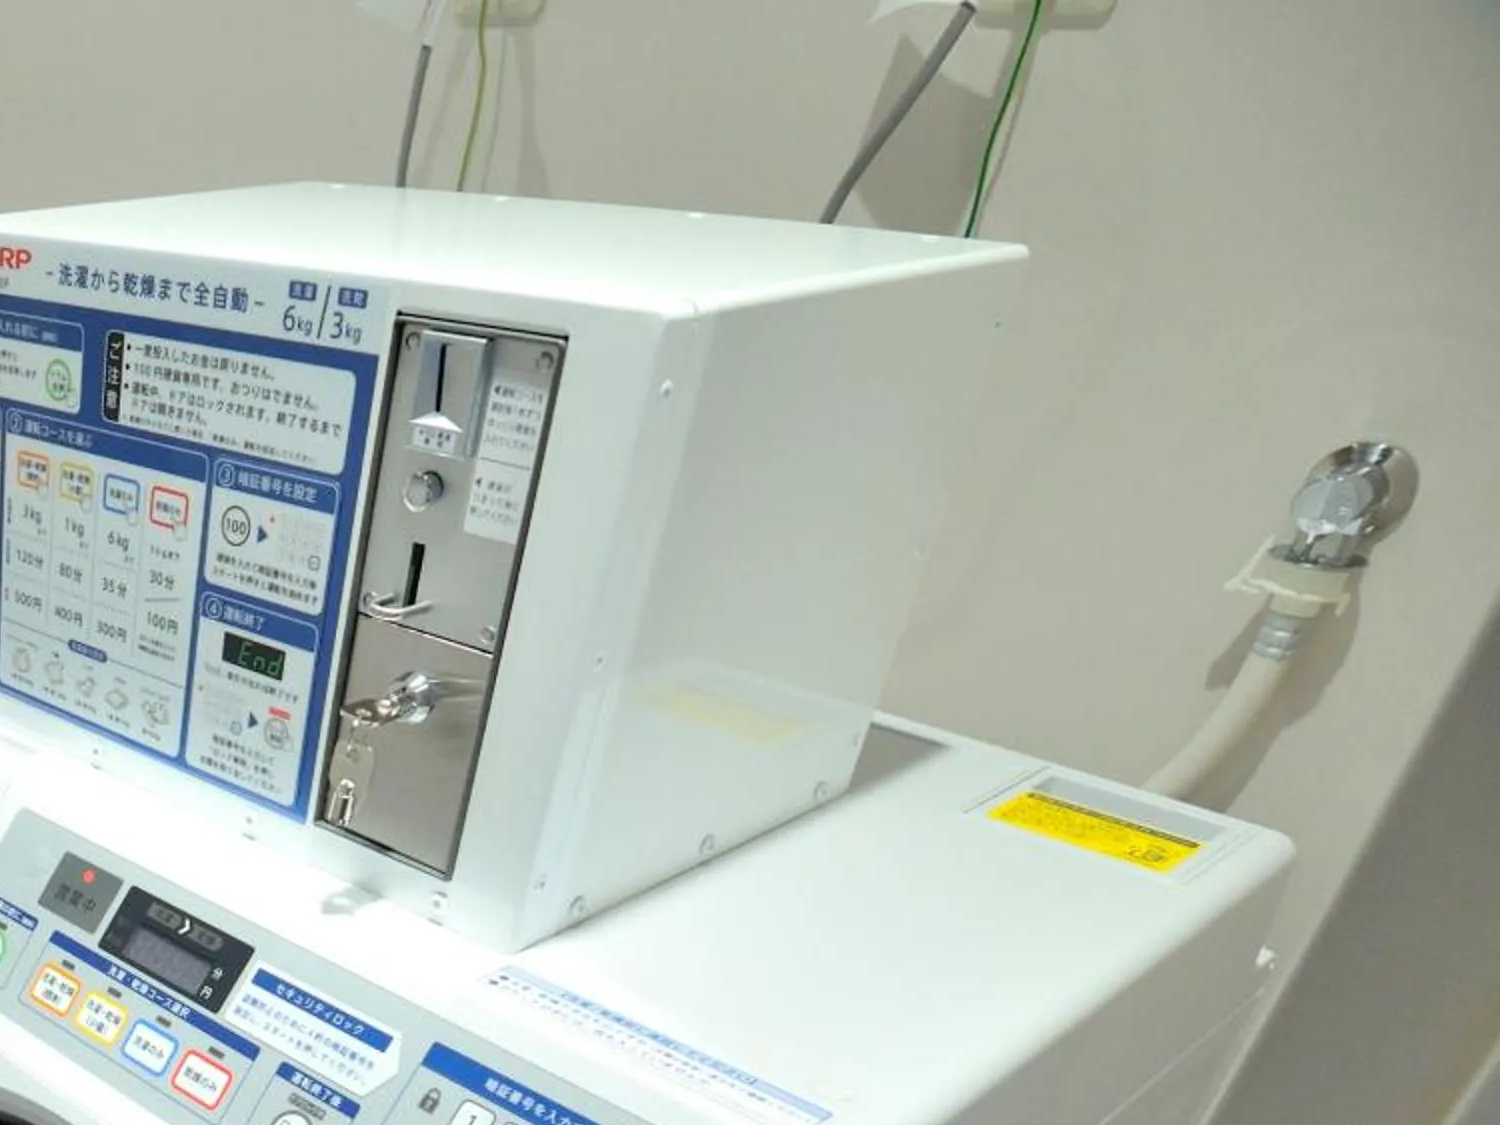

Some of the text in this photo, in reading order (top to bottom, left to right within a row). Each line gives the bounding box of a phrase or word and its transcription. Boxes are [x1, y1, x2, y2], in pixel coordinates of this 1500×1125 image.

[282, 305, 363, 345] 6kg 3kg
[226, 518, 247, 535] 100
[147, 611, 179, 635] 100円
[238, 641, 284, 676] End
[213, 966, 226, 981] 分
[200, 985, 213, 1000] 円
[275, 982, 365, 1037] セキュリティロック
